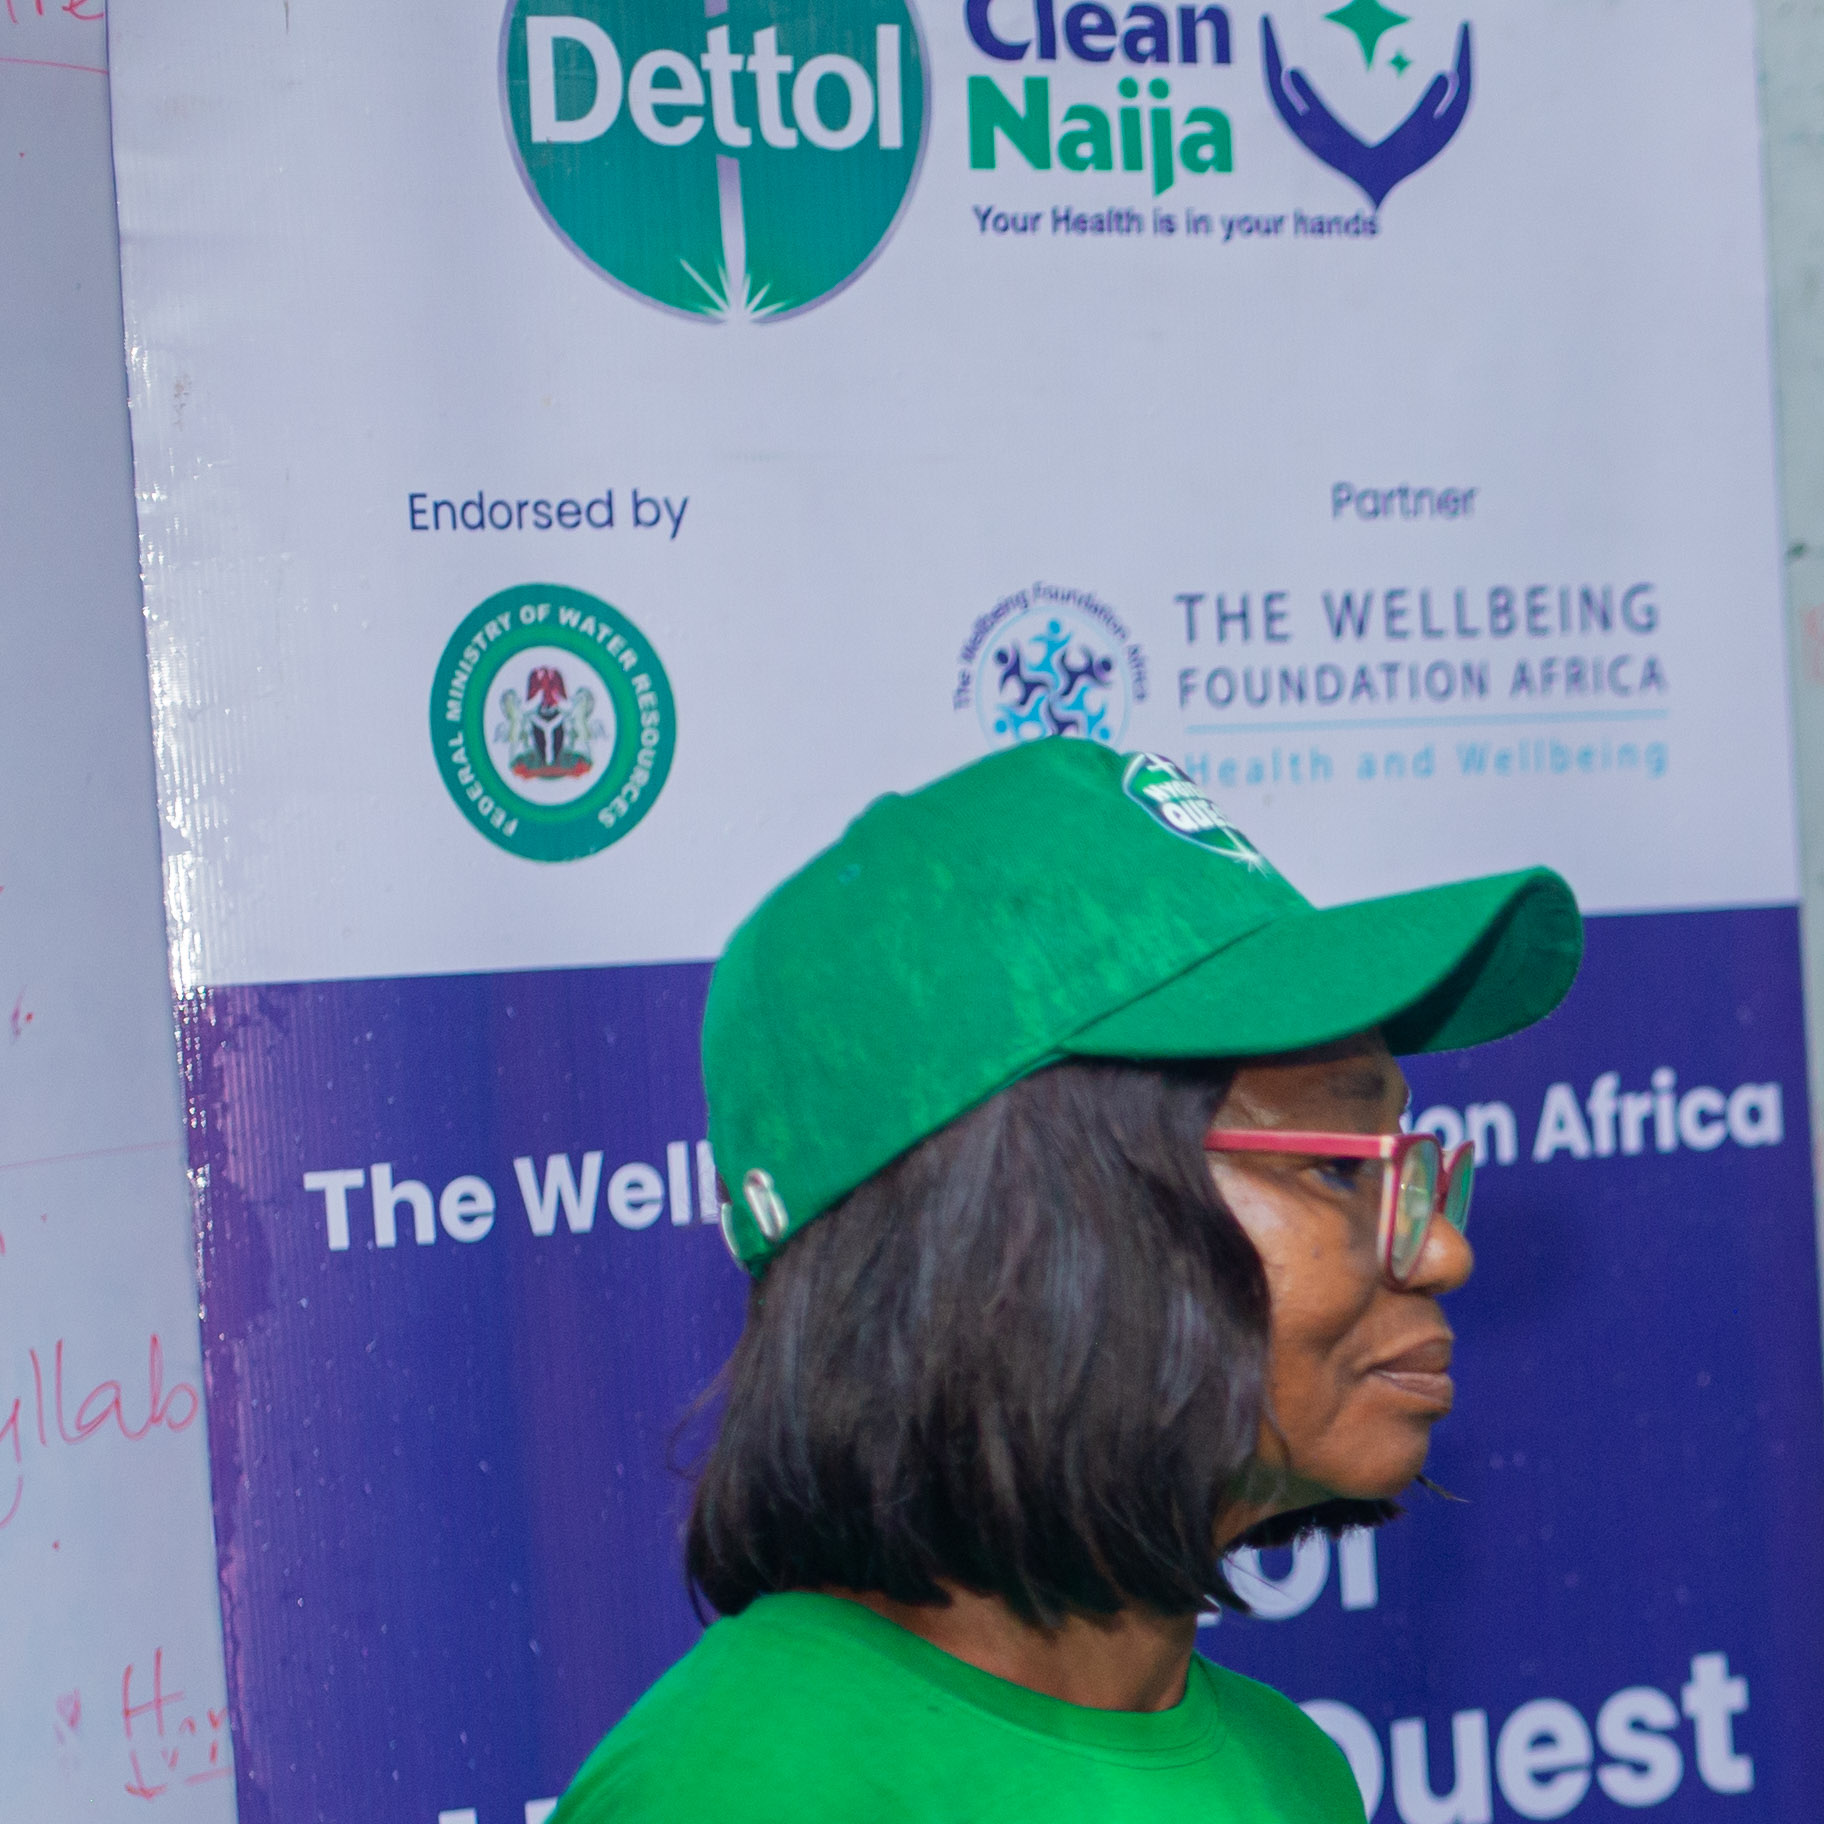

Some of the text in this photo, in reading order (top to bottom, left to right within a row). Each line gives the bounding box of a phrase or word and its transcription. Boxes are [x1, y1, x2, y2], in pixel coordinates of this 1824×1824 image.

[963, 0, 1233, 66] Clean
[525, 16, 905, 152] Dettol
[966, 75, 1235, 198] Naija
[973, 204, 1382, 243] Your Health is in your hands
[408, 490, 690, 540] Endorsed by
[1331, 480, 1478, 520] Partner
[1173, 581, 1661, 645] THE WELLBEING
[1177, 653, 1669, 709] FOUNDATION AFRICA
[446, 603, 661, 837] FEDERAL MINISTRY OF WATER RESOURCES
[1184, 737, 1670, 789] Health and Wellbeing
[1531, 1065, 1785, 1164] Africa
[303, 1161, 496, 1251] The
